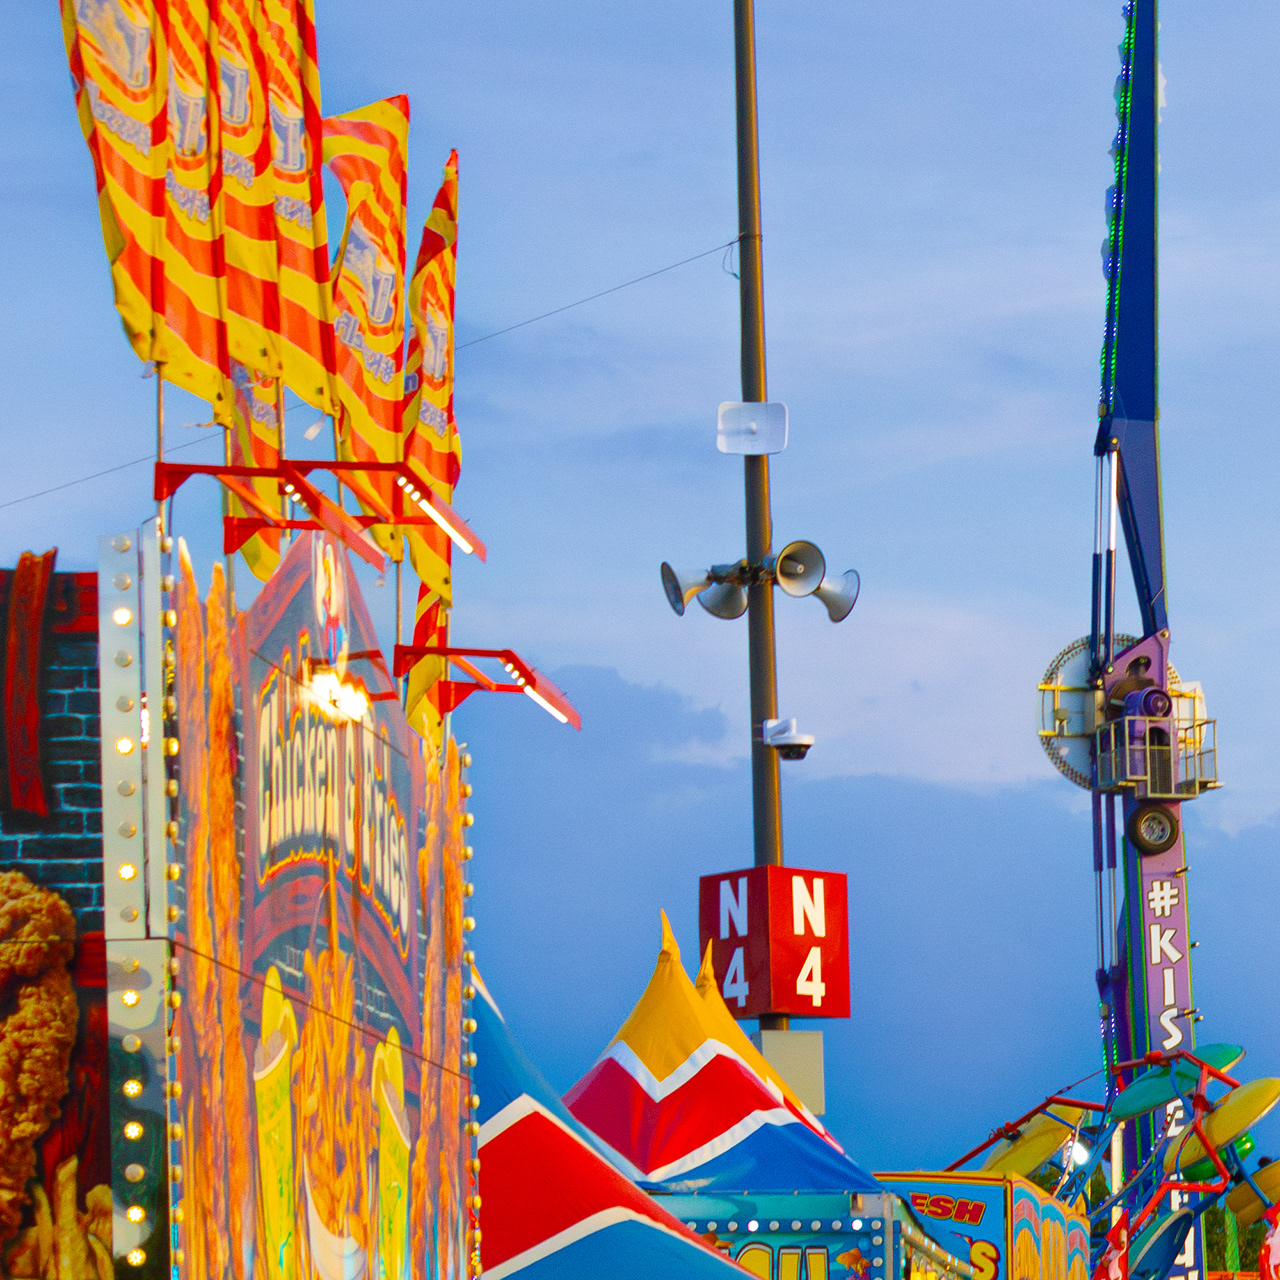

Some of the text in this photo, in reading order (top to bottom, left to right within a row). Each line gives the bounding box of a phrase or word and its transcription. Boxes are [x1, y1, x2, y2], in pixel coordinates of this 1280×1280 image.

[720, 877, 749, 939] N
[793, 876, 827, 940] N
[721, 948, 749, 1009] 4
[796, 945, 827, 1008] 4
